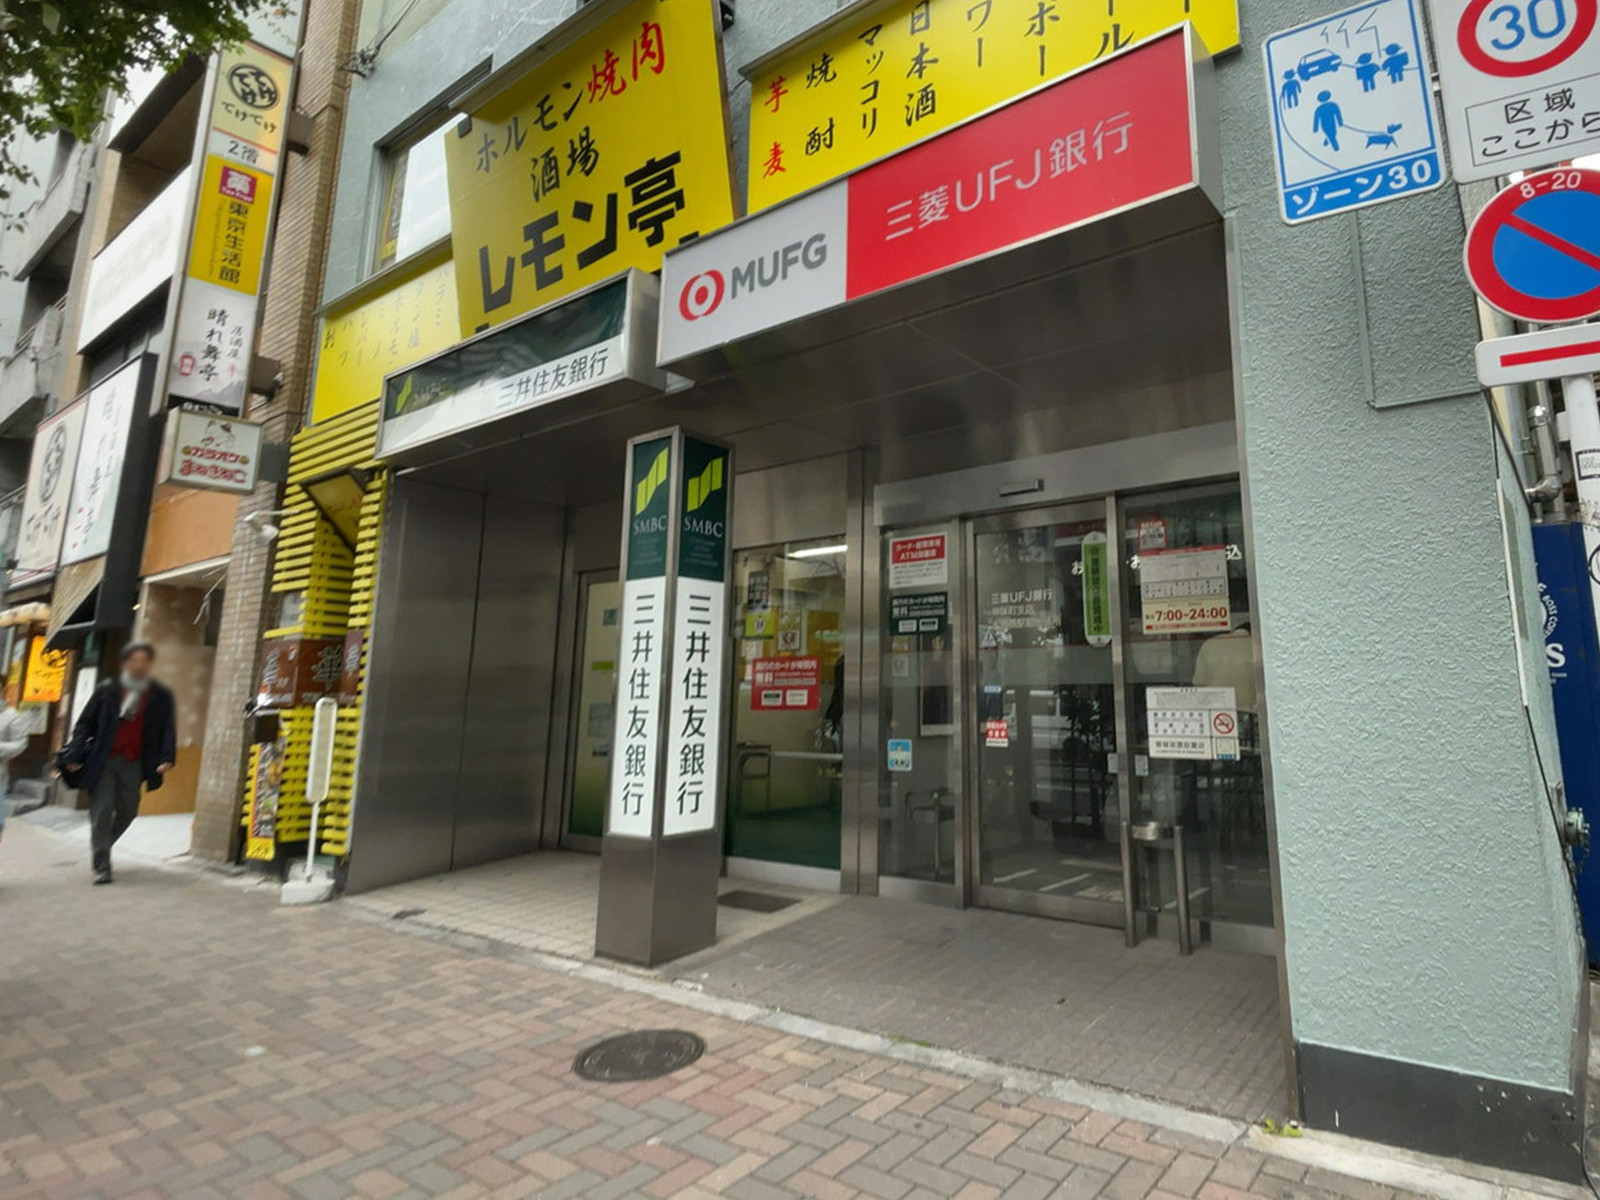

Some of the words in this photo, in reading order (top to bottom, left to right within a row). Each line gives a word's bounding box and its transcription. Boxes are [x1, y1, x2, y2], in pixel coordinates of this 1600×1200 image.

[1489, 0, 1566, 50] 30
[857, 23, 884, 139] マッコリ
[905, 1, 939, 127] 日本酒
[221, 101, 278, 134] てけてけ
[476, 21, 666, 174] ホルモン焼肉
[1504, 87, 1576, 124] 区域
[531, 125, 600, 202] 酒場
[1482, 111, 1600, 157] ここから
[885, 111, 1134, 241] 三菱UFJ銀行
[1292, 158, 1432, 216] ゾーン30
[1520, 171, 1582, 199] 8-20
[479, 150, 685, 314] レモン亭
[731, 232, 828, 300] MUFG
[497, 347, 609, 409] 三井住友銀行
[633, 514, 668, 537] SMBC
[683, 516, 724, 538] SMBC
[621, 594, 655, 816] 三井住友銀行
[676, 595, 711, 816] 三井住友銀行
